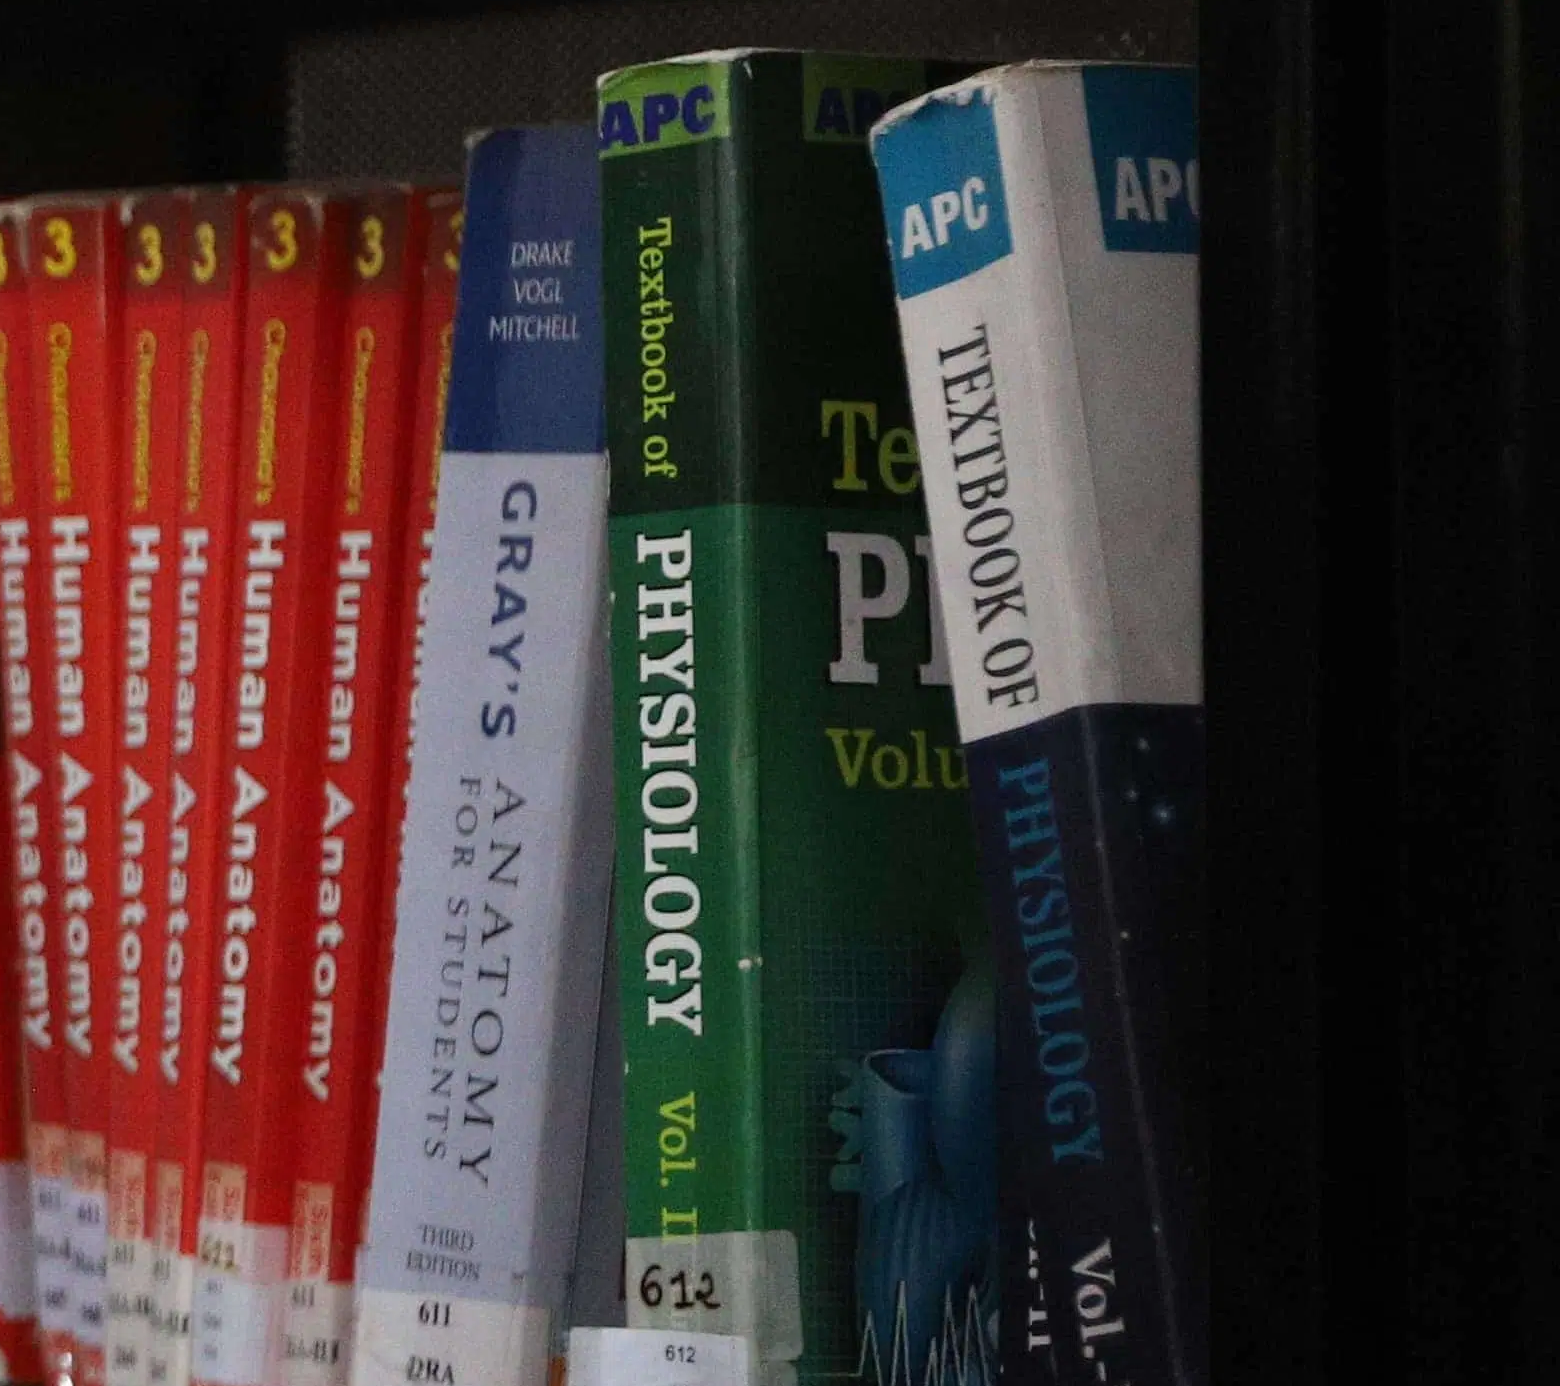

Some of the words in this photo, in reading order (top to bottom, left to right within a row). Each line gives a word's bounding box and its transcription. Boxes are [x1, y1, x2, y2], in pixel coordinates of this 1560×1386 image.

[599, 84, 715, 149] APC
[43, 217, 76, 278] 3
[135, 224, 164, 286] 3
[192, 221, 216, 284] 3
[266, 211, 298, 272] 3
[356, 216, 386, 278] 3
[511, 240, 575, 269] DRAKE
[512, 278, 564, 305] VOGL
[901, 176, 989, 261] APC
[489, 315, 580, 342] MITCHELL
[638, 217, 674, 423] Textbook
[643, 436, 677, 479] of
[938, 323, 1028, 631] TEXTBOOK
[984, 638, 1040, 710] OF
[50, 516, 90, 737] Human
[124, 524, 160, 749] Human
[173, 528, 209, 755] Human
[236, 519, 286, 749] Human
[327, 529, 373, 762] Human
[481, 481, 537, 740] GRAY'S
[451, 776, 482, 869] FOR
[636, 529, 702, 1036] PHYSIOLOGY
[11, 750, 53, 1051] Anatomy
[59, 751, 95, 1058] Anatomy
[112, 763, 154, 1075] Anatomy
[160, 772, 197, 1086] Anatomy
[212, 765, 269, 1087] Anatomy
[303, 781, 355, 1103] Anatomy
[998, 757, 1104, 1168] PHYSIOLOGY
[423, 895, 471, 1162] STUDENTS
[457, 777, 527, 1189] ANATOMY
[659, 1091, 697, 1190] Vol.
[406, 1253, 481, 1282] EDITION
[418, 1223, 475, 1253] THIRD
[639, 1264, 720, 1312] 612
[418, 1301, 451, 1328] 611
[664, 1345, 696, 1365] 612
